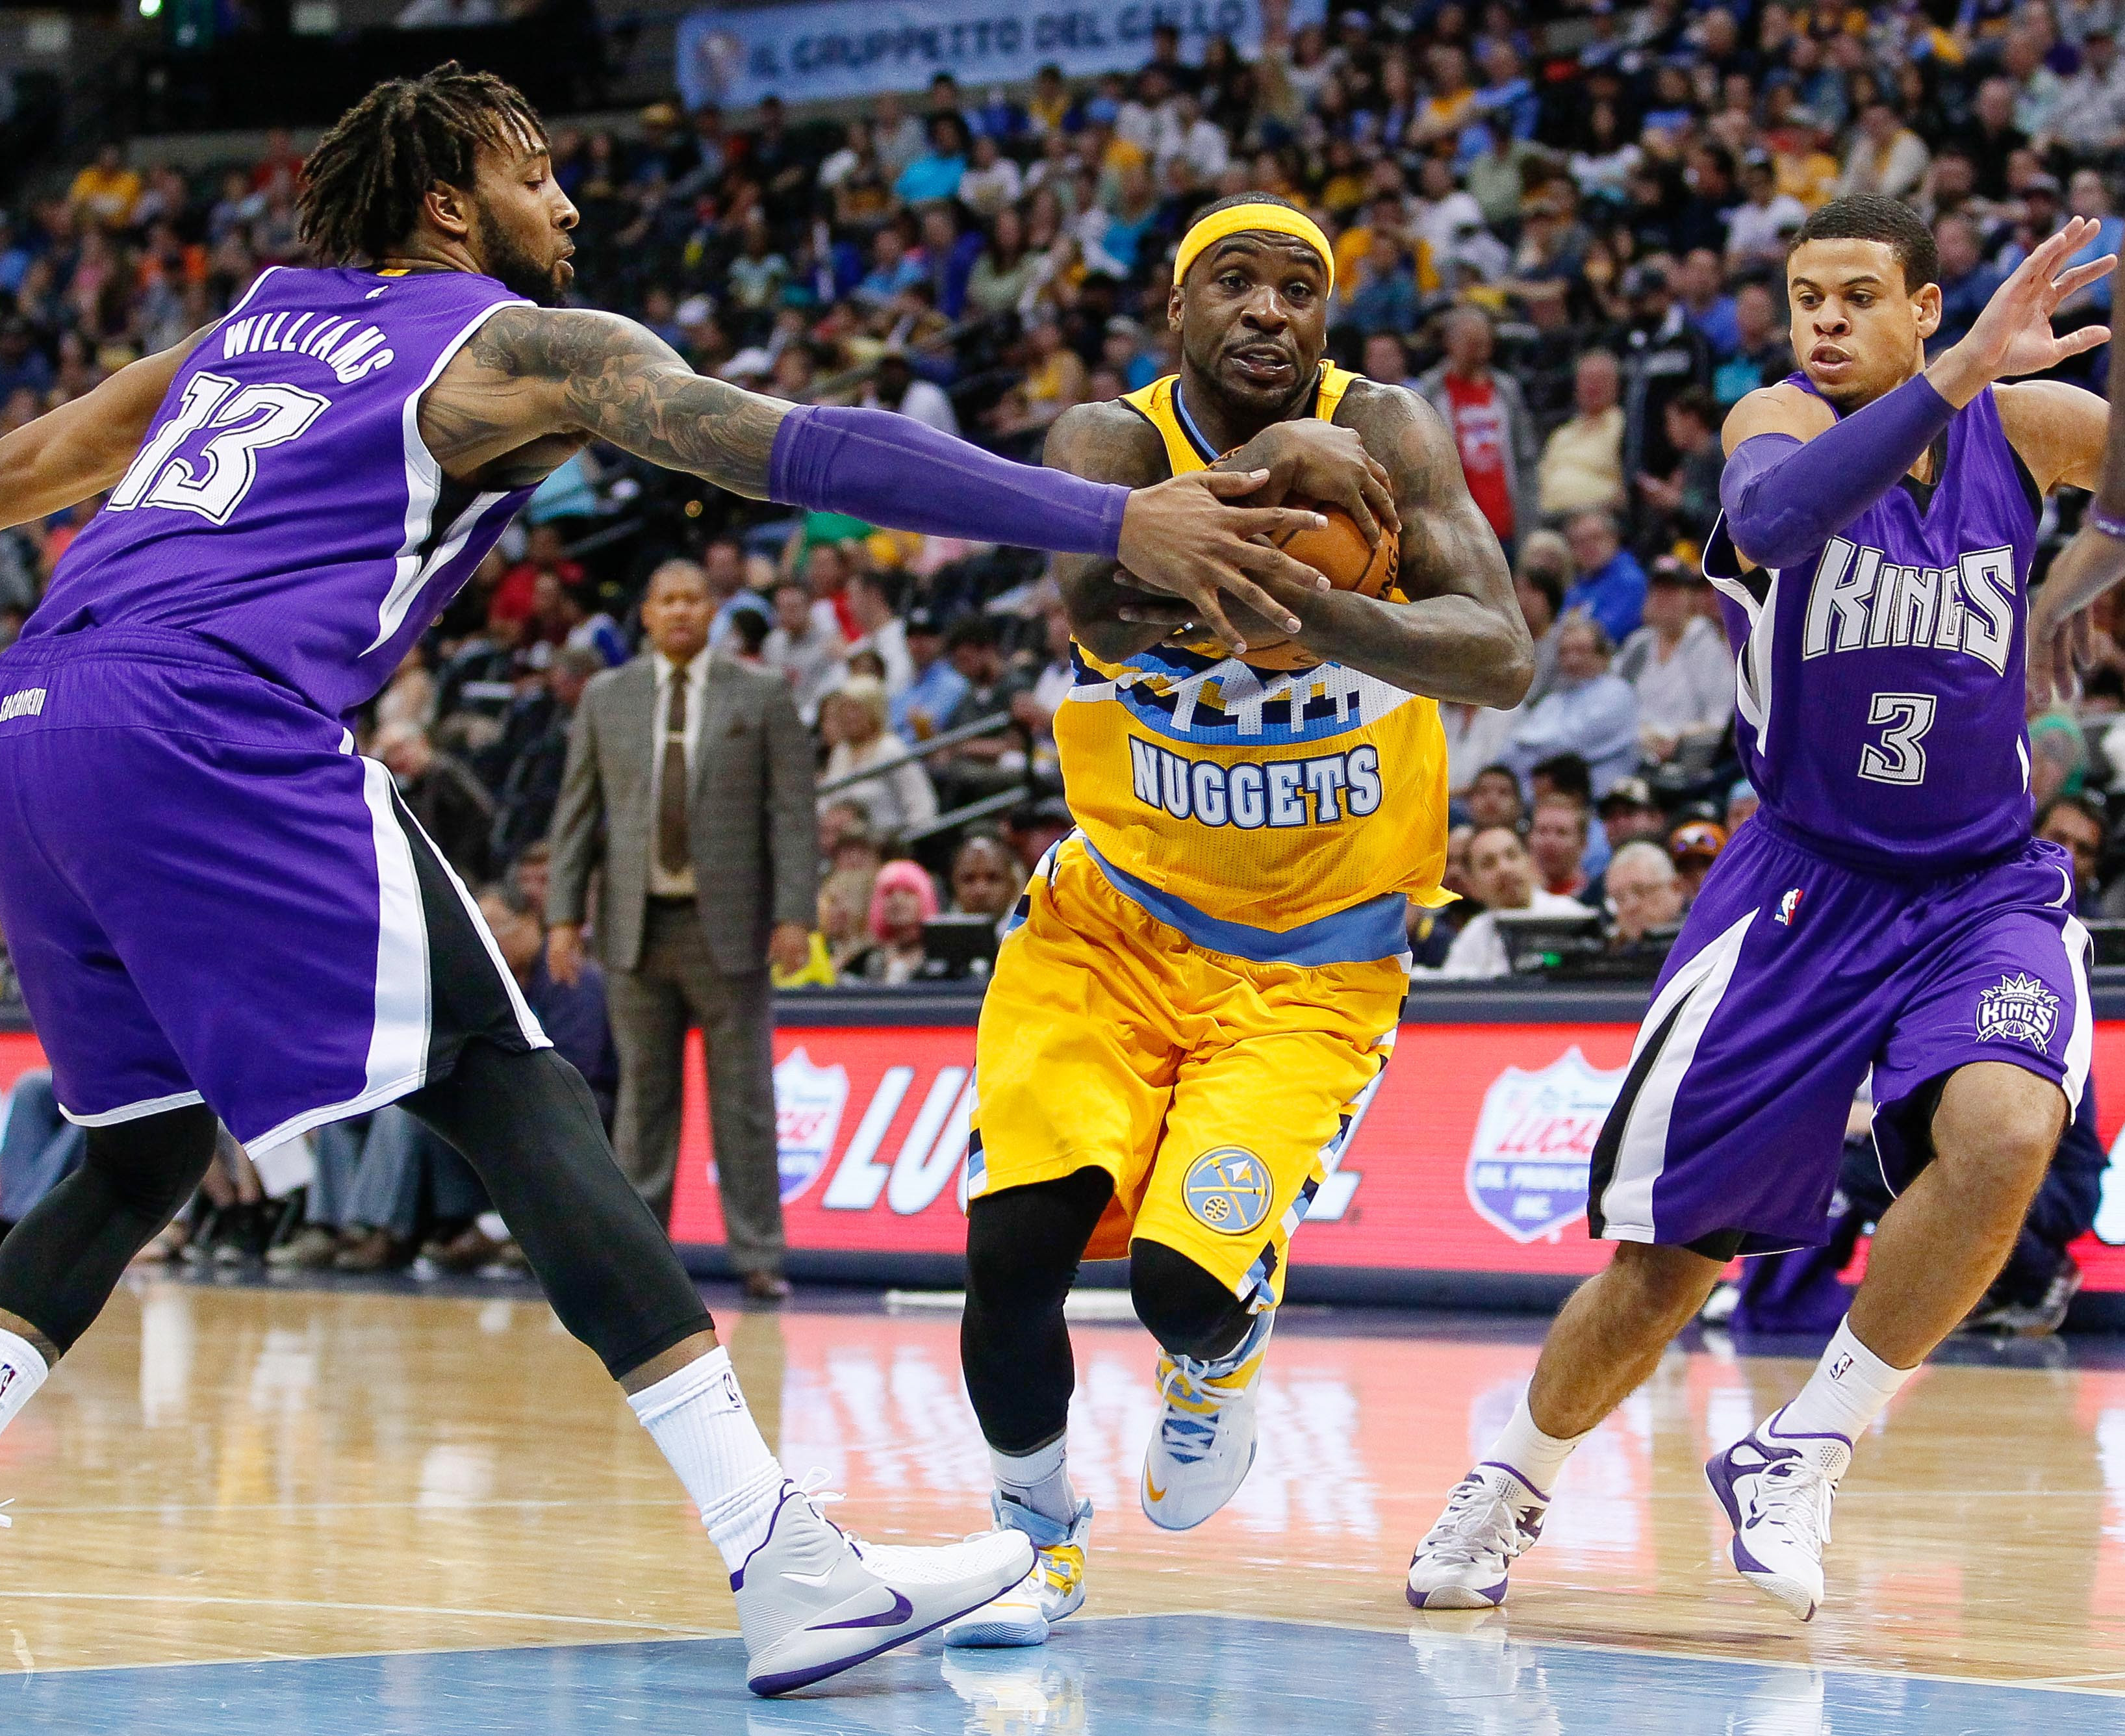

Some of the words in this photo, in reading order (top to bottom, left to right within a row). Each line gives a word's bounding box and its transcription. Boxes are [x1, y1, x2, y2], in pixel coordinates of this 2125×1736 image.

[1036, 11, 1106, 48] DEL
[222, 311, 396, 384] WILLIAMS
[105, 370, 333, 526] 13
[1801, 535, 2016, 678] KINGS
[1128, 734, 1383, 830] NUGGETS
[1858, 693, 1937, 785] 3
[1981, 1001, 2054, 1035] KINGS
[822, 1066, 973, 1215] LU
